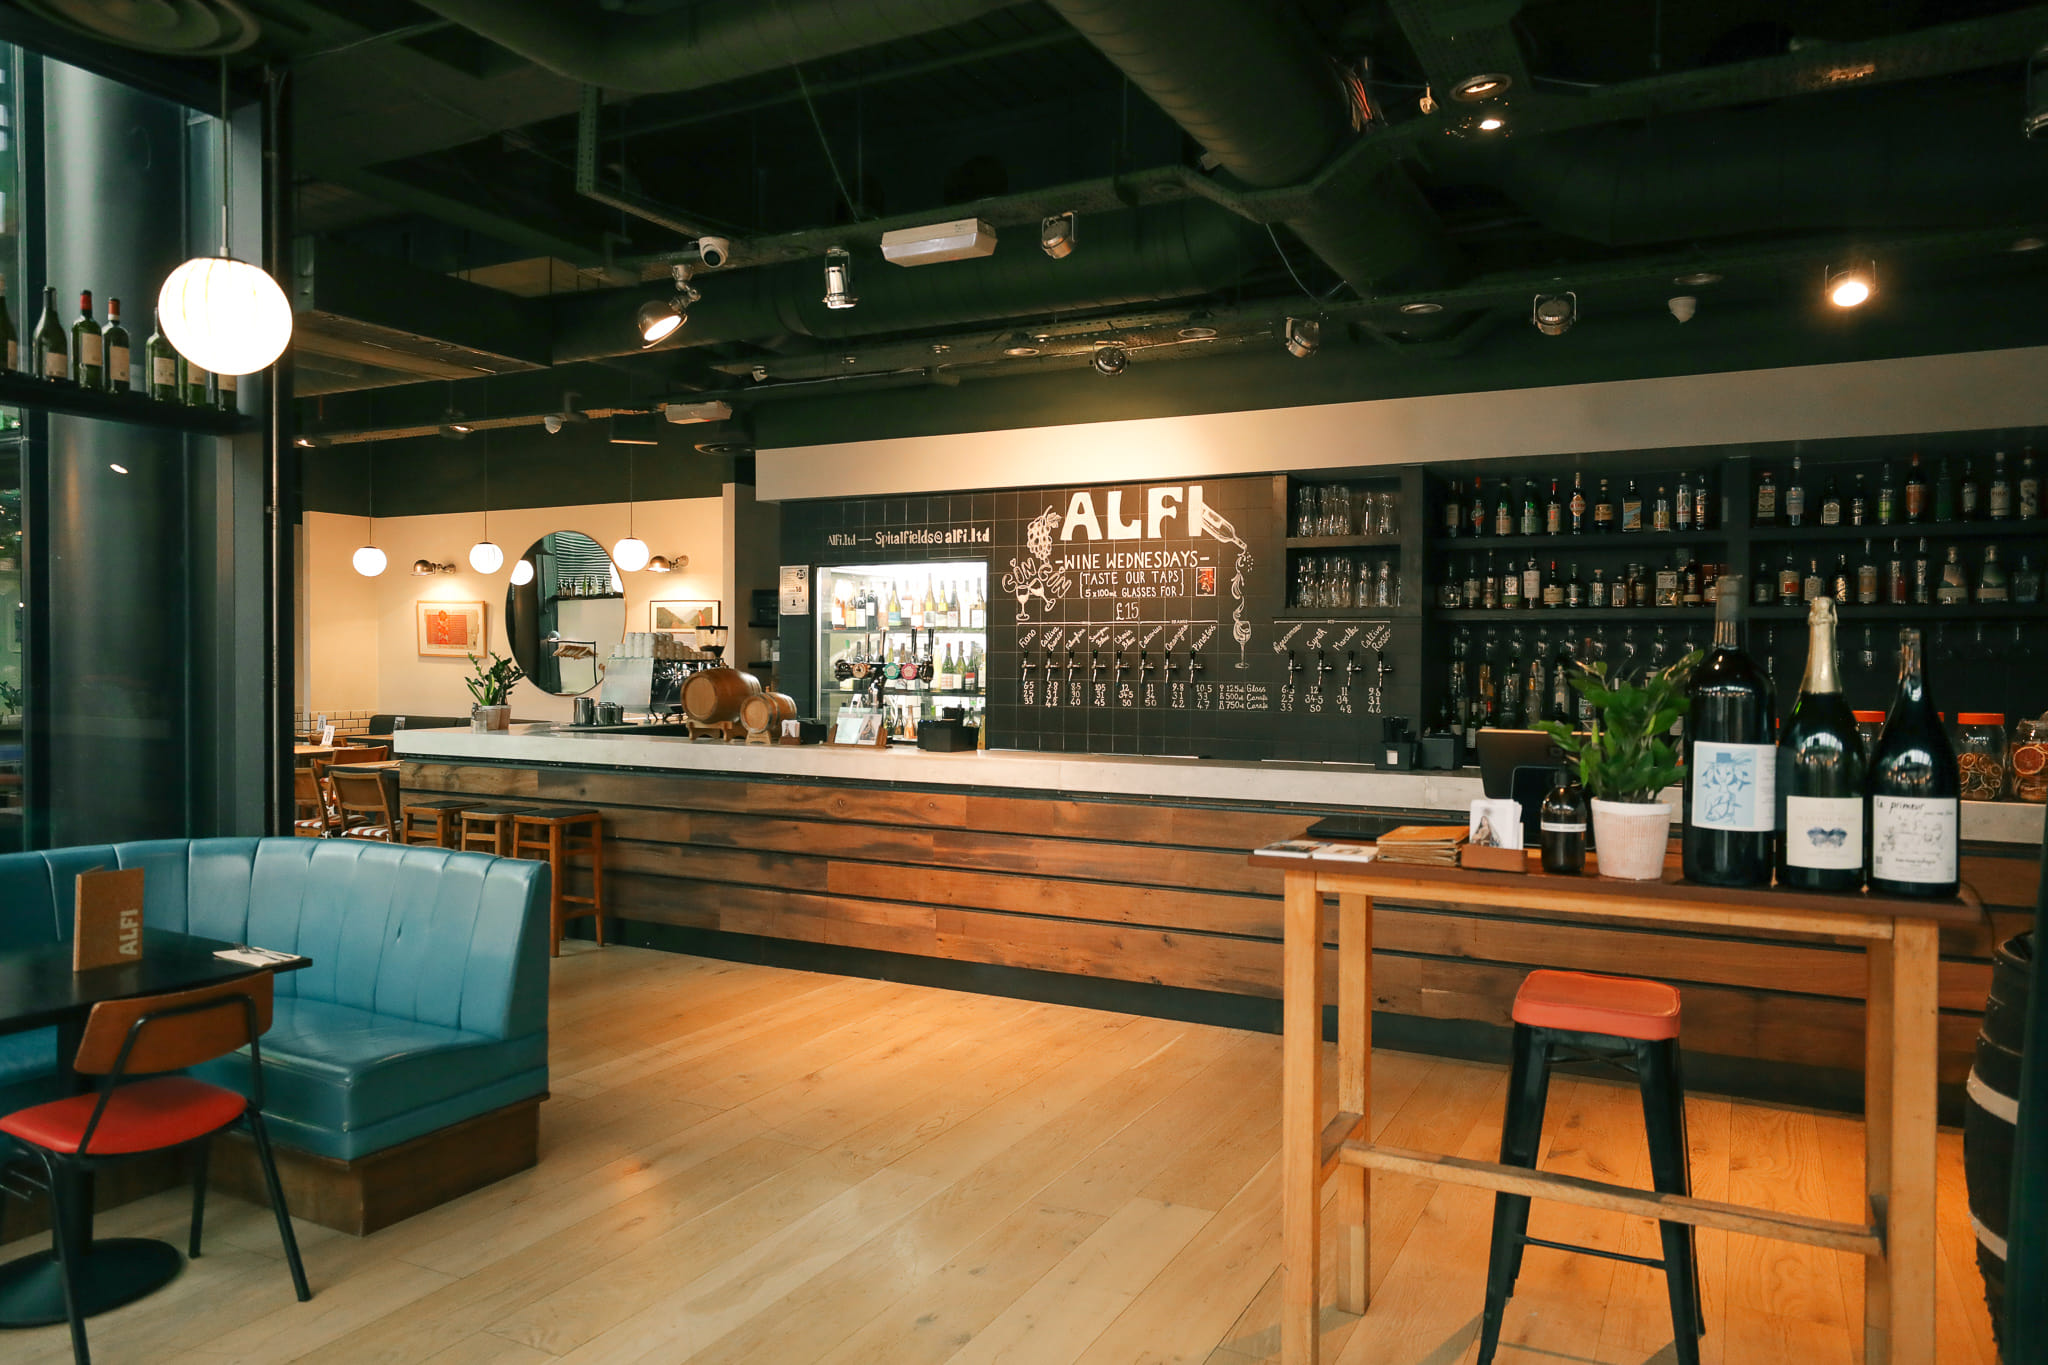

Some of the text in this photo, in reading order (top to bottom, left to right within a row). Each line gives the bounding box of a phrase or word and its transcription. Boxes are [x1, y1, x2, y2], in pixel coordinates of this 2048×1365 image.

[1060, 485, 1203, 541] ALFI
[1083, 569, 1179, 585] TASTE OUR TAPS
[1121, 587, 1157, 597] GLASSES
[1160, 586, 1177, 597] FOR
[1116, 601, 1139, 620] £15
[1371, 628, 1392, 652] Rosso
[1172, 692, 1184, 700] 31
[1281, 694, 1294, 703] 25
[1368, 696, 1381, 705] 31
[1070, 698, 1081, 706] 40
[1094, 698, 1106, 706] 45
[1172, 700, 1185, 709] 42
[1197, 700, 1210, 710] 47
[1280, 702, 1293, 712] 33
[1310, 704, 1322, 713] 50
[1340, 704, 1352, 714] 48
[1368, 704, 1382, 714] 46
[119, 909, 138, 955] ALFI
